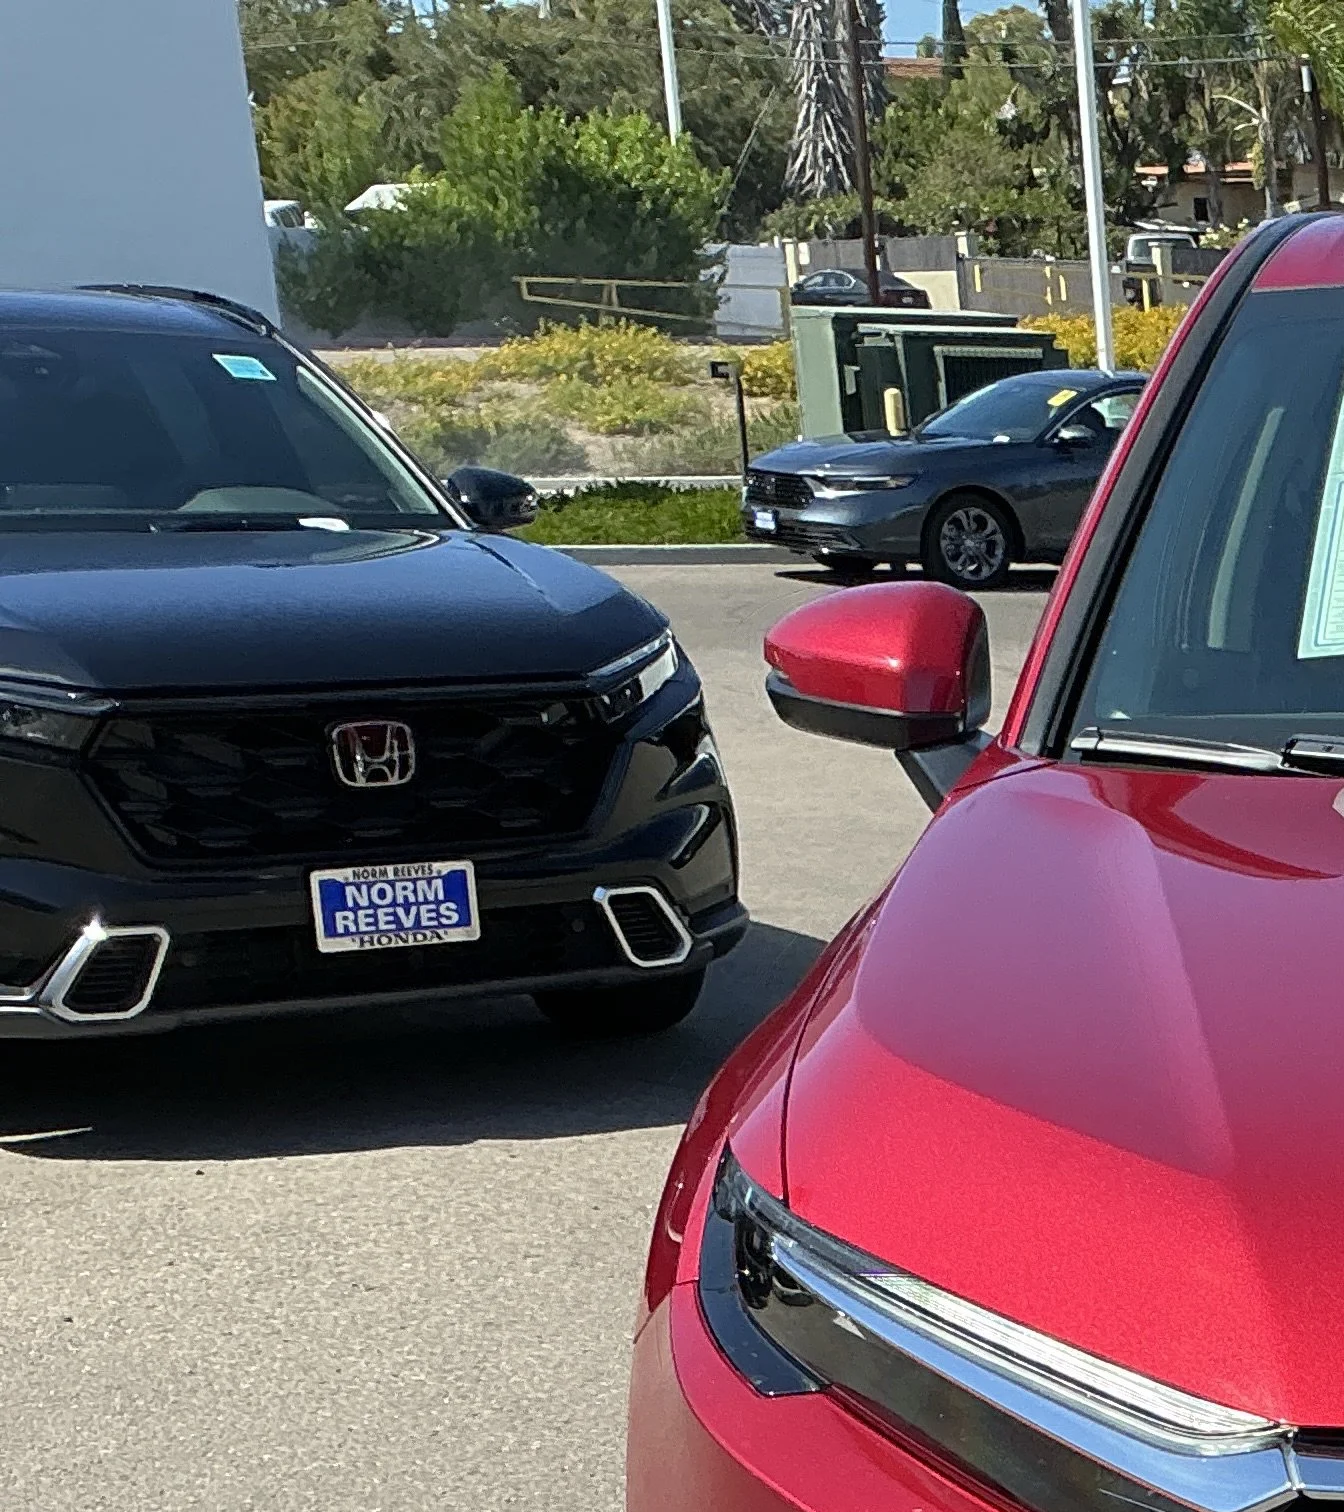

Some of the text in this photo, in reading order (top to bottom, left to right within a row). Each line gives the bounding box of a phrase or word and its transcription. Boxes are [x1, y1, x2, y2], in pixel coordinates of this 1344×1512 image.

[353, 864, 434, 880] NORM REEVES
[345, 879, 444, 908] NORM
[335, 902, 460, 933] REEVES
[359, 930, 444, 948] HONDA
